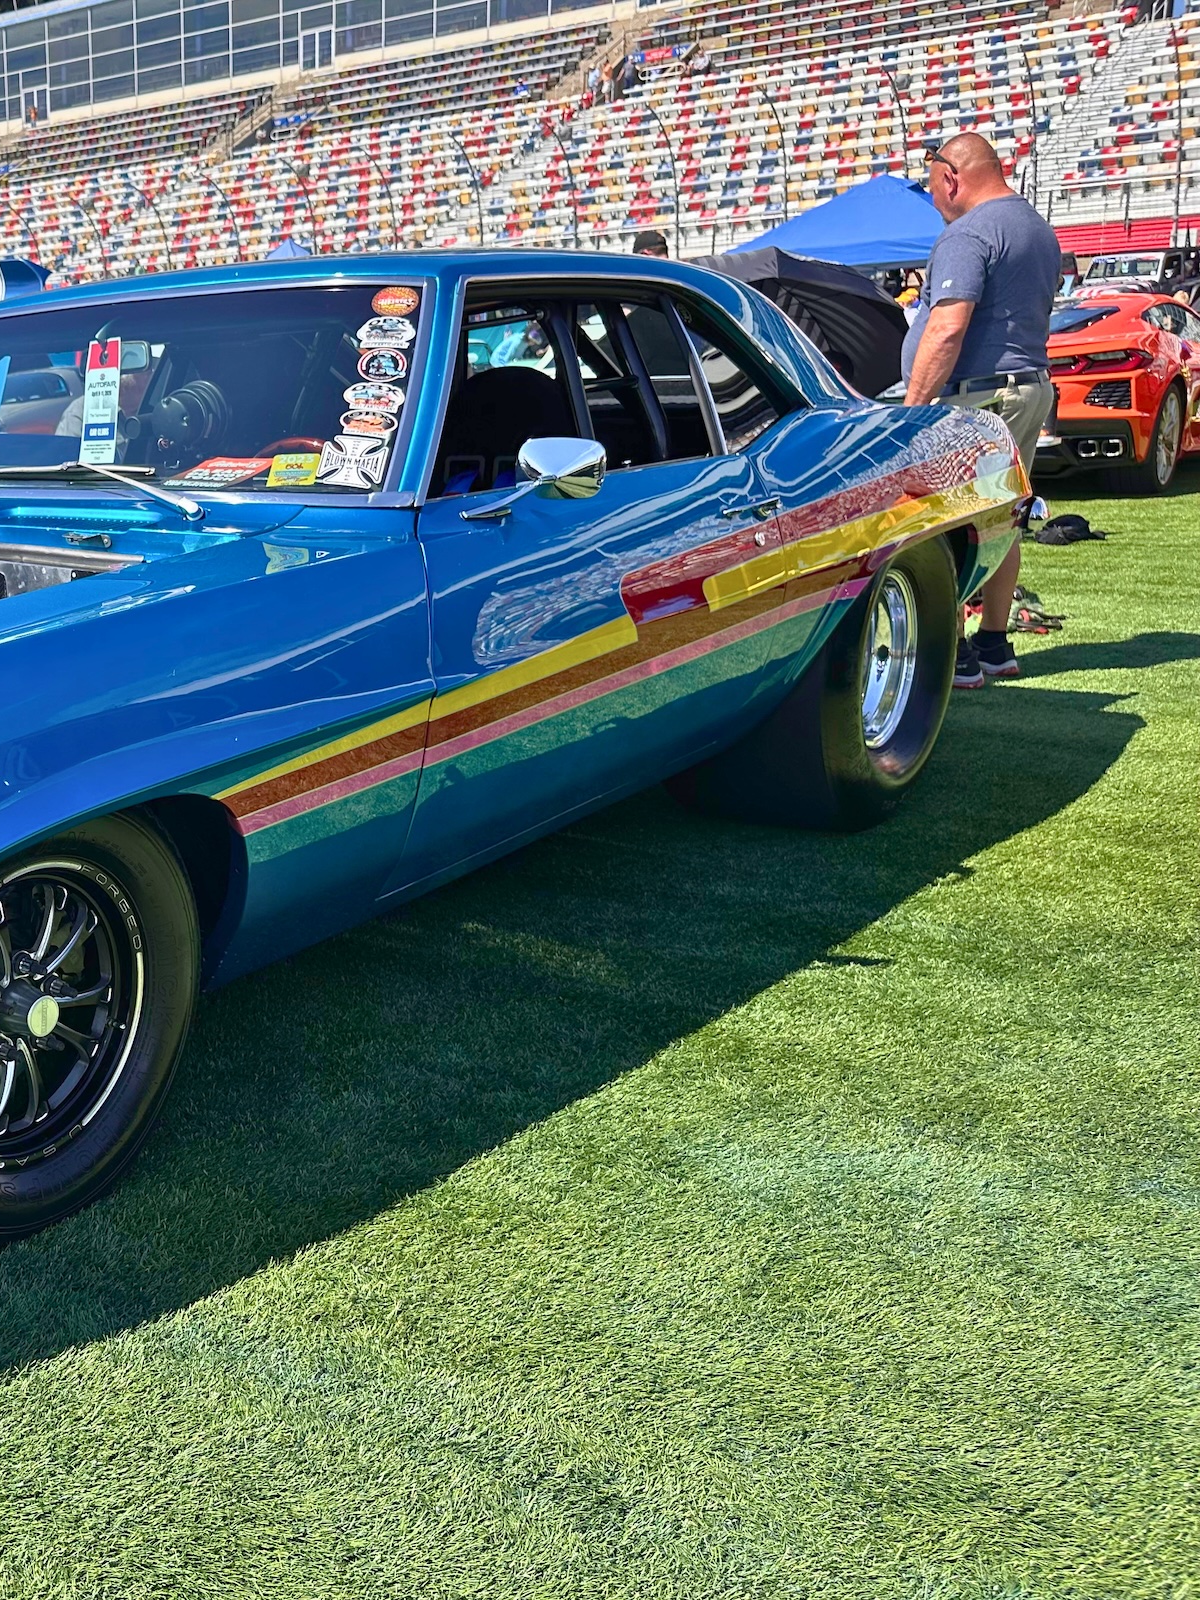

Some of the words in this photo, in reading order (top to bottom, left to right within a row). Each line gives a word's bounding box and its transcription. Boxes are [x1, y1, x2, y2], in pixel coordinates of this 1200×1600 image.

[88, 381, 117, 391] AUTOFAIR
[278, 453, 315, 464] 2023
[324, 451, 353, 468] BLOWN
[354, 456, 379, 474] MAFIA
[80, 864, 143, 951] FORGED
[15, 1124, 83, 1166] USA
